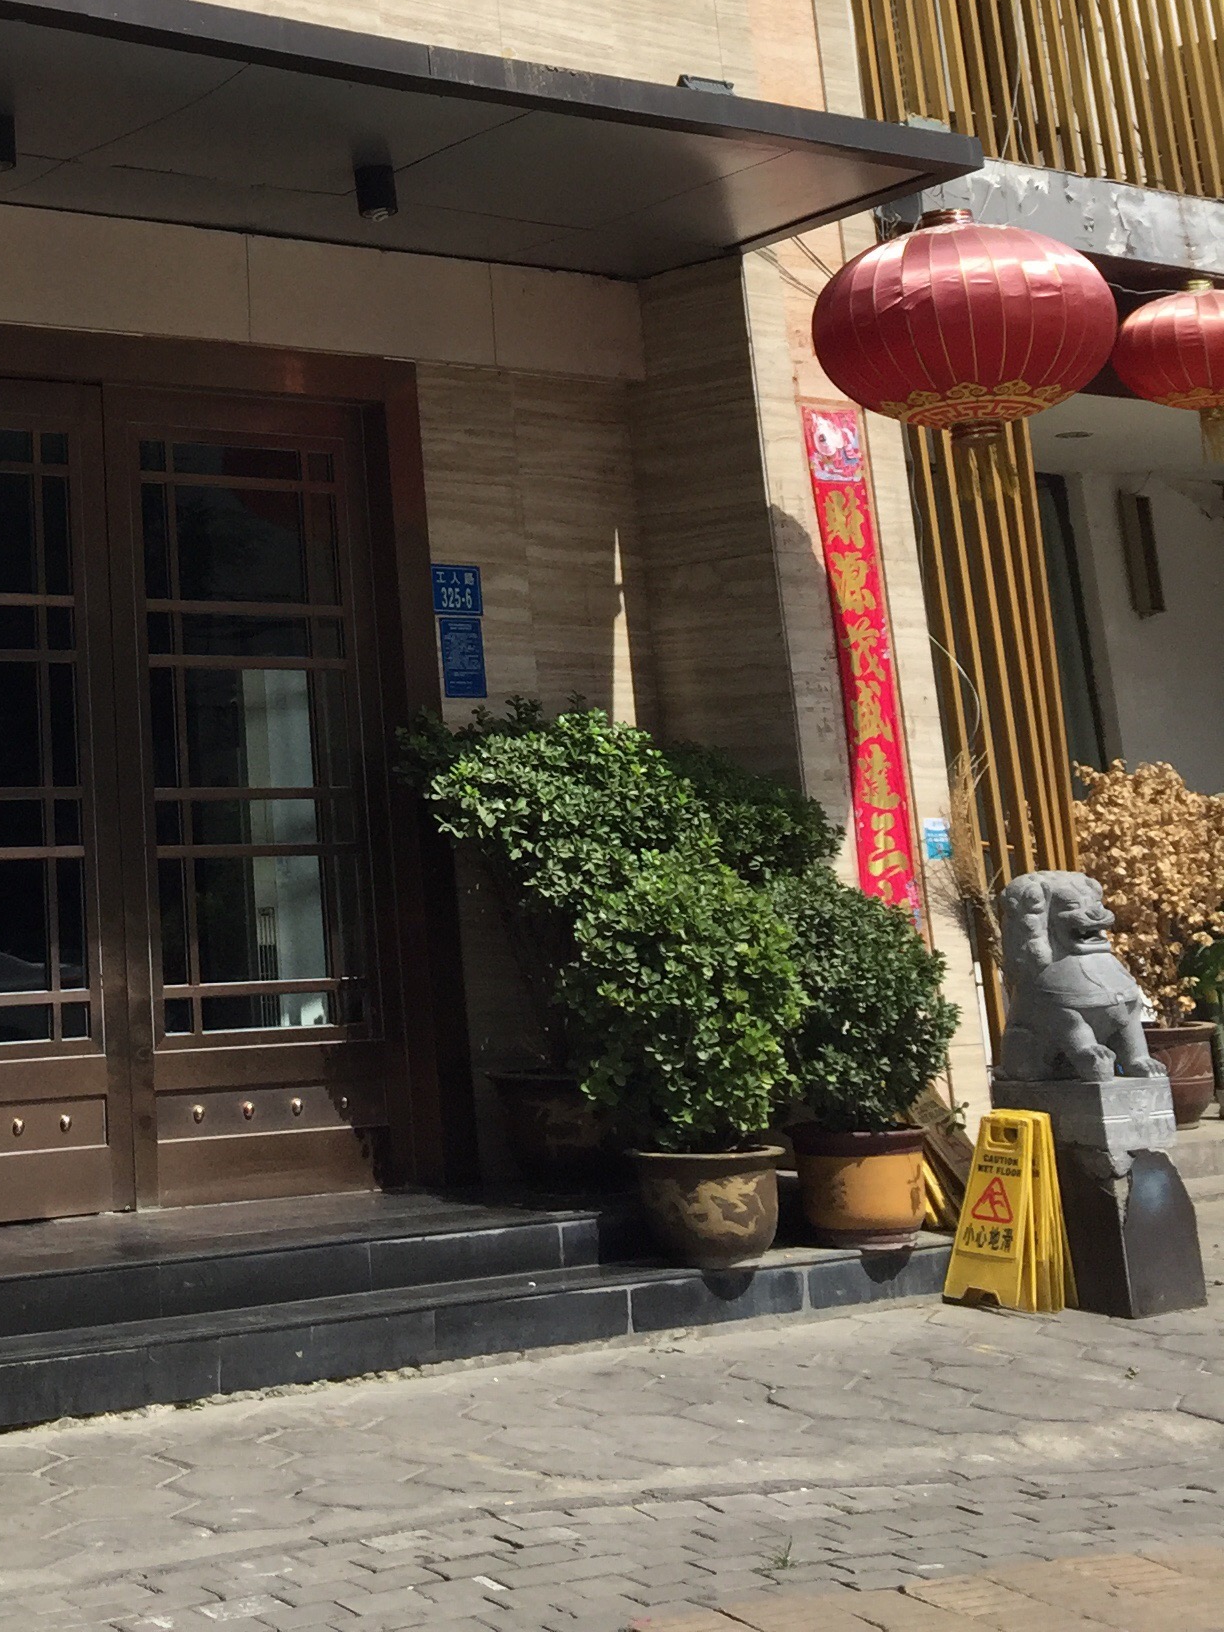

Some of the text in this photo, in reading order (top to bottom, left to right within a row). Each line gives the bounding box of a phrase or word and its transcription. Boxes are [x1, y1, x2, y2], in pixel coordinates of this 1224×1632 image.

[436, 571, 475, 585] 工人路
[824, 486, 912, 915] 財源茂盛達三
[983, 1154, 1019, 1166] CAUTION
[978, 1164, 994, 1174] WET
[996, 1167, 1021, 1177] FLOOR
[963, 1222, 1014, 1253] 小心地滑
